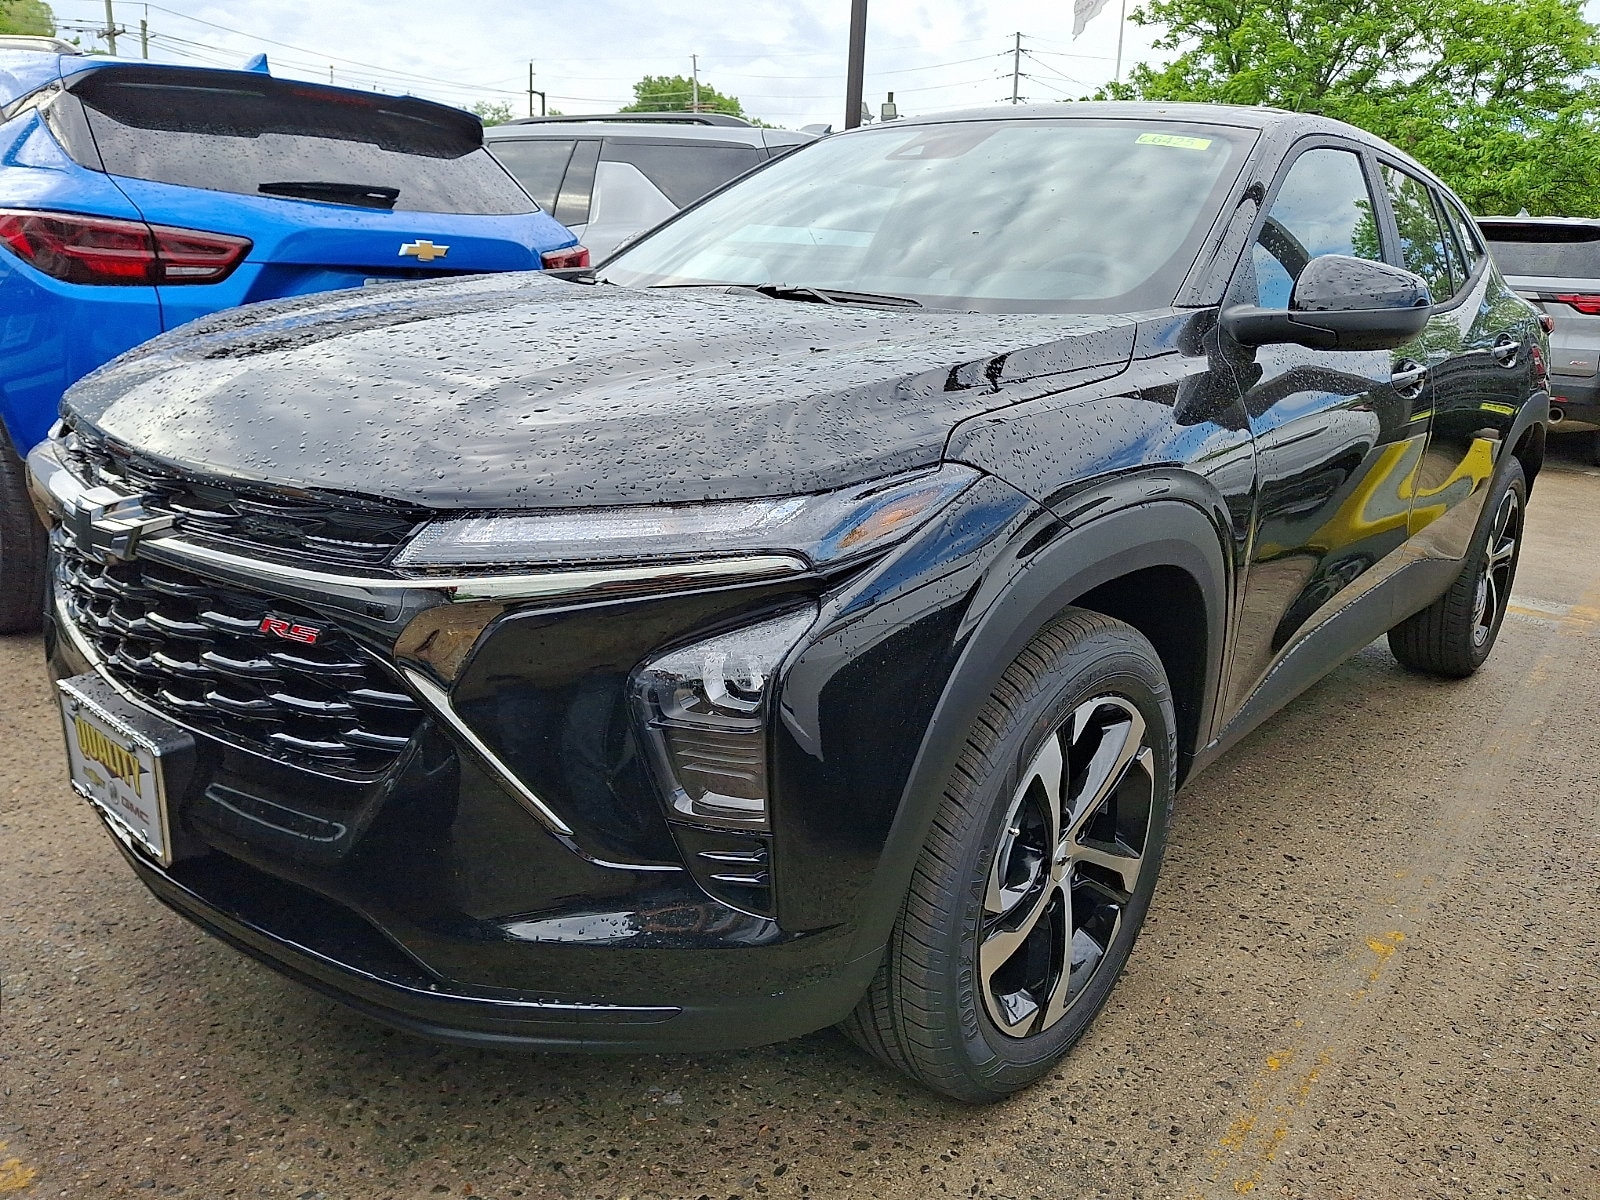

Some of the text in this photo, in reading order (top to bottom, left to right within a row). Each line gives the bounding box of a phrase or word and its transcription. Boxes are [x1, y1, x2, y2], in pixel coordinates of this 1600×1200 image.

[260, 616, 320, 644] RS
[74, 713, 142, 799] QUALITY
[121, 796, 149, 825] GMC
